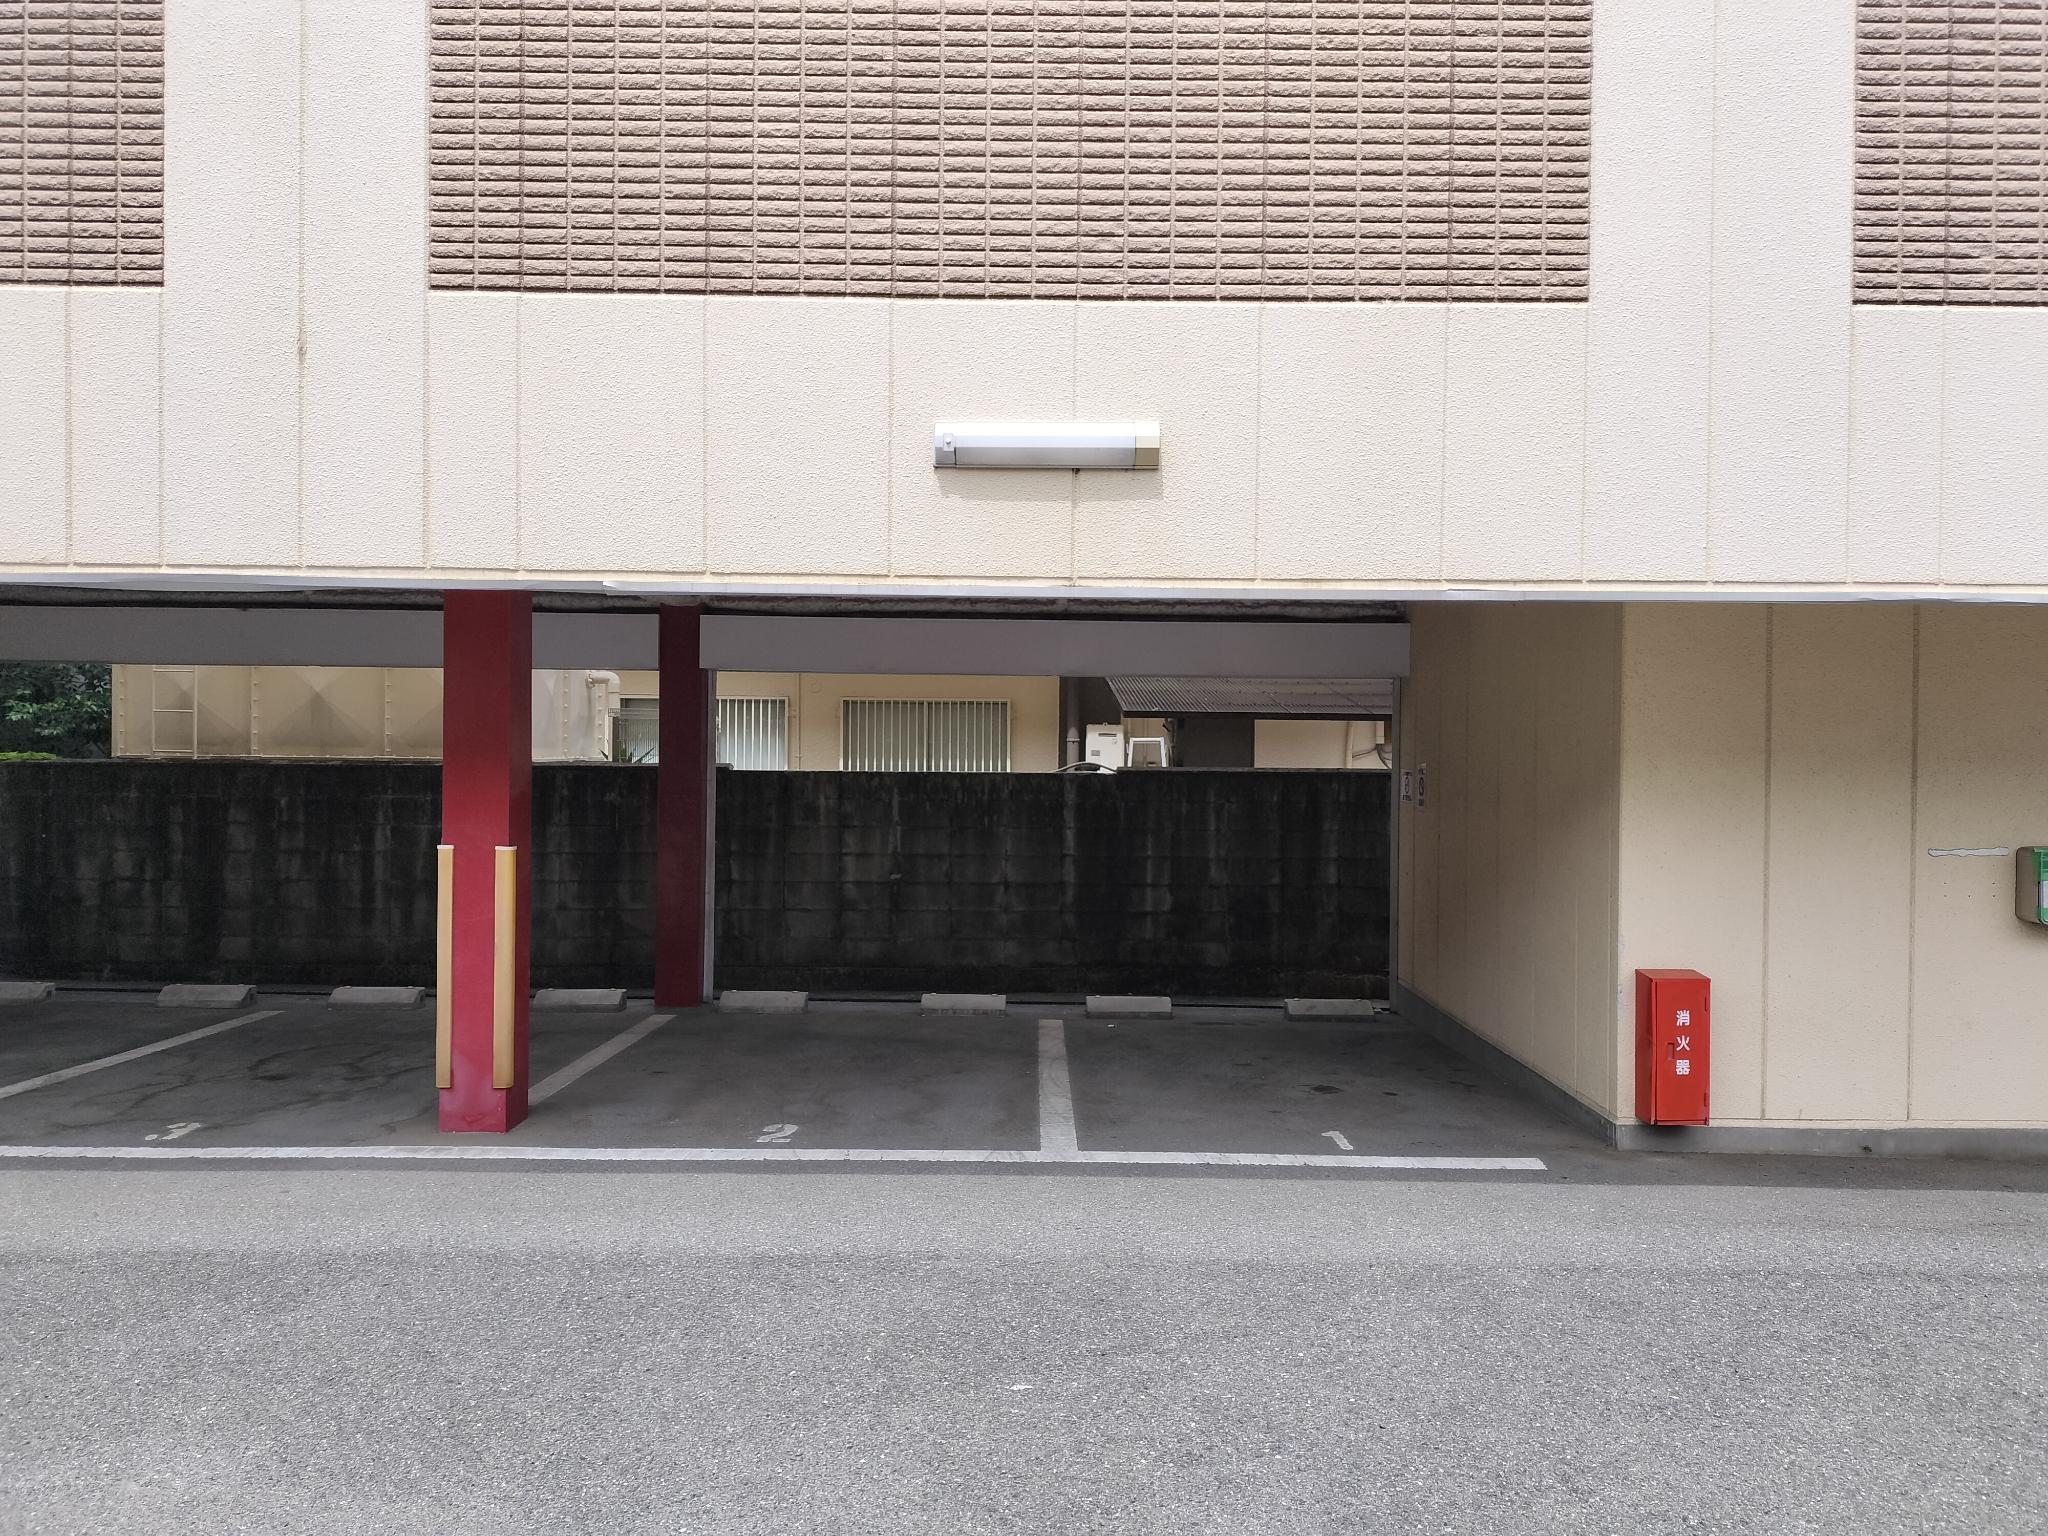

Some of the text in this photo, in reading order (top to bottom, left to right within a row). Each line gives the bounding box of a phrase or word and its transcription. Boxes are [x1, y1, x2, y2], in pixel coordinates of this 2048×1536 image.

[1675, 1009, 1691, 1076] 消火器
[756, 1123, 799, 1143] 2
[1321, 1130, 1354, 1151] 1
